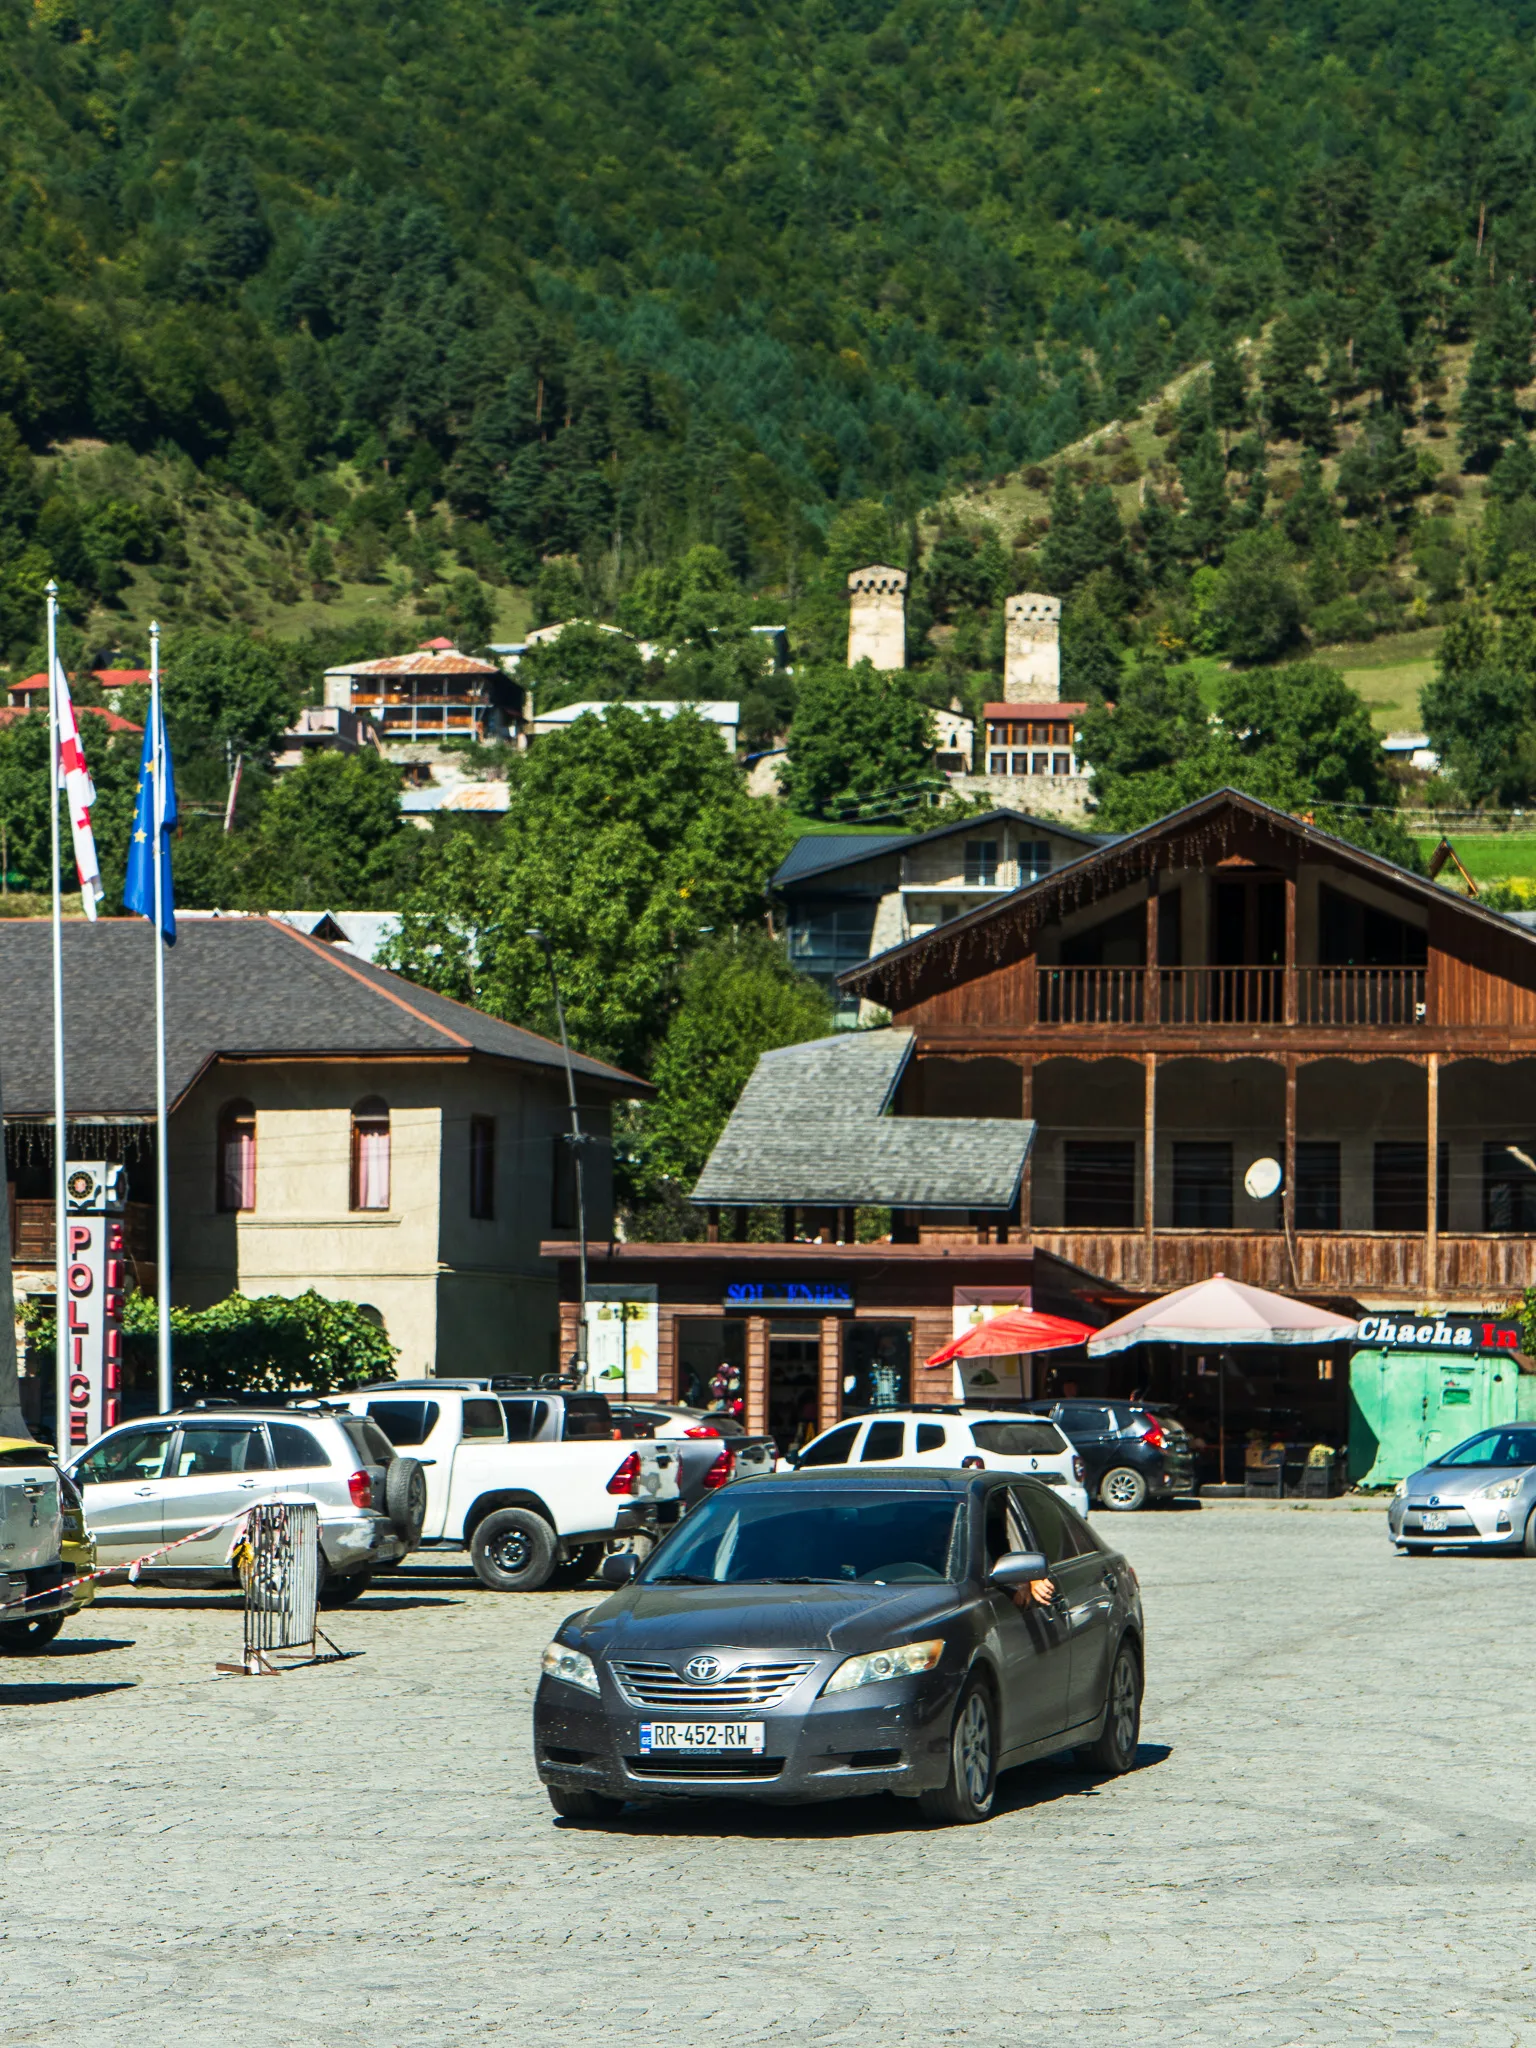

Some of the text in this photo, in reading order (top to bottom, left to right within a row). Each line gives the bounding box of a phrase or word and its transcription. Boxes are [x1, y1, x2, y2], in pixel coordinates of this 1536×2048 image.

[68, 1226, 92, 1439] POLICE
[1357, 1316, 1518, 1348] Chacha In
[654, 1725, 748, 1745] RR-452-RW
